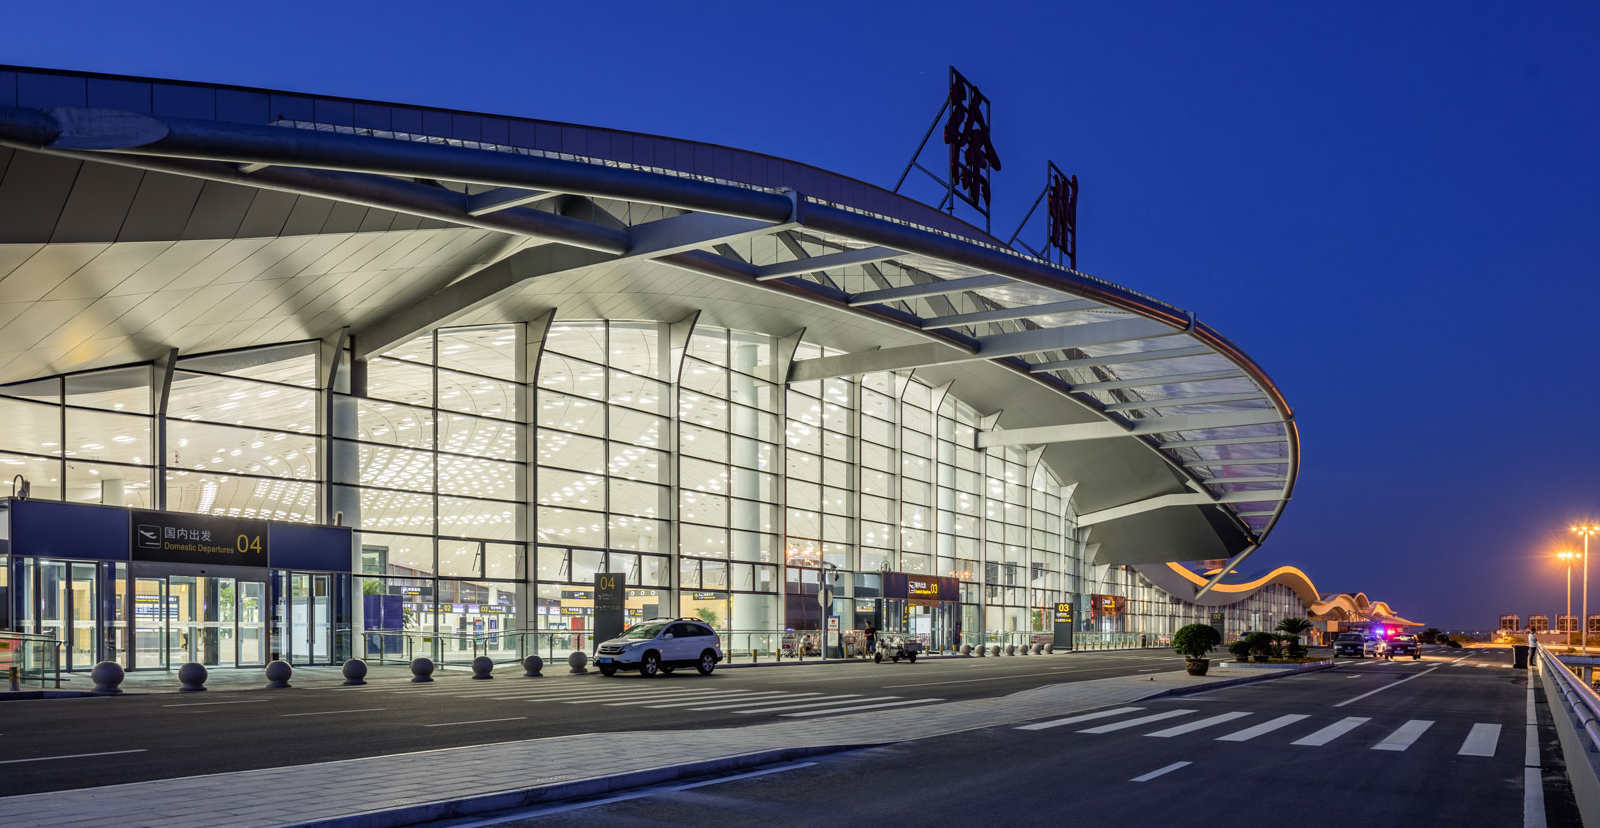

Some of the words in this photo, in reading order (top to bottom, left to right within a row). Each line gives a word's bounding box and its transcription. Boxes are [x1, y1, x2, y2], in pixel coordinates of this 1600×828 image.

[164, 526, 212, 541] 国内出发
[164, 541, 197, 552] Domestic
[198, 544, 234, 554] Departures
[236, 534, 262, 554] 04
[600, 576, 615, 590] 04
[931, 583, 938, 594] 03
[443, 604, 453, 613] 02
[1058, 603, 1069, 612] 03
